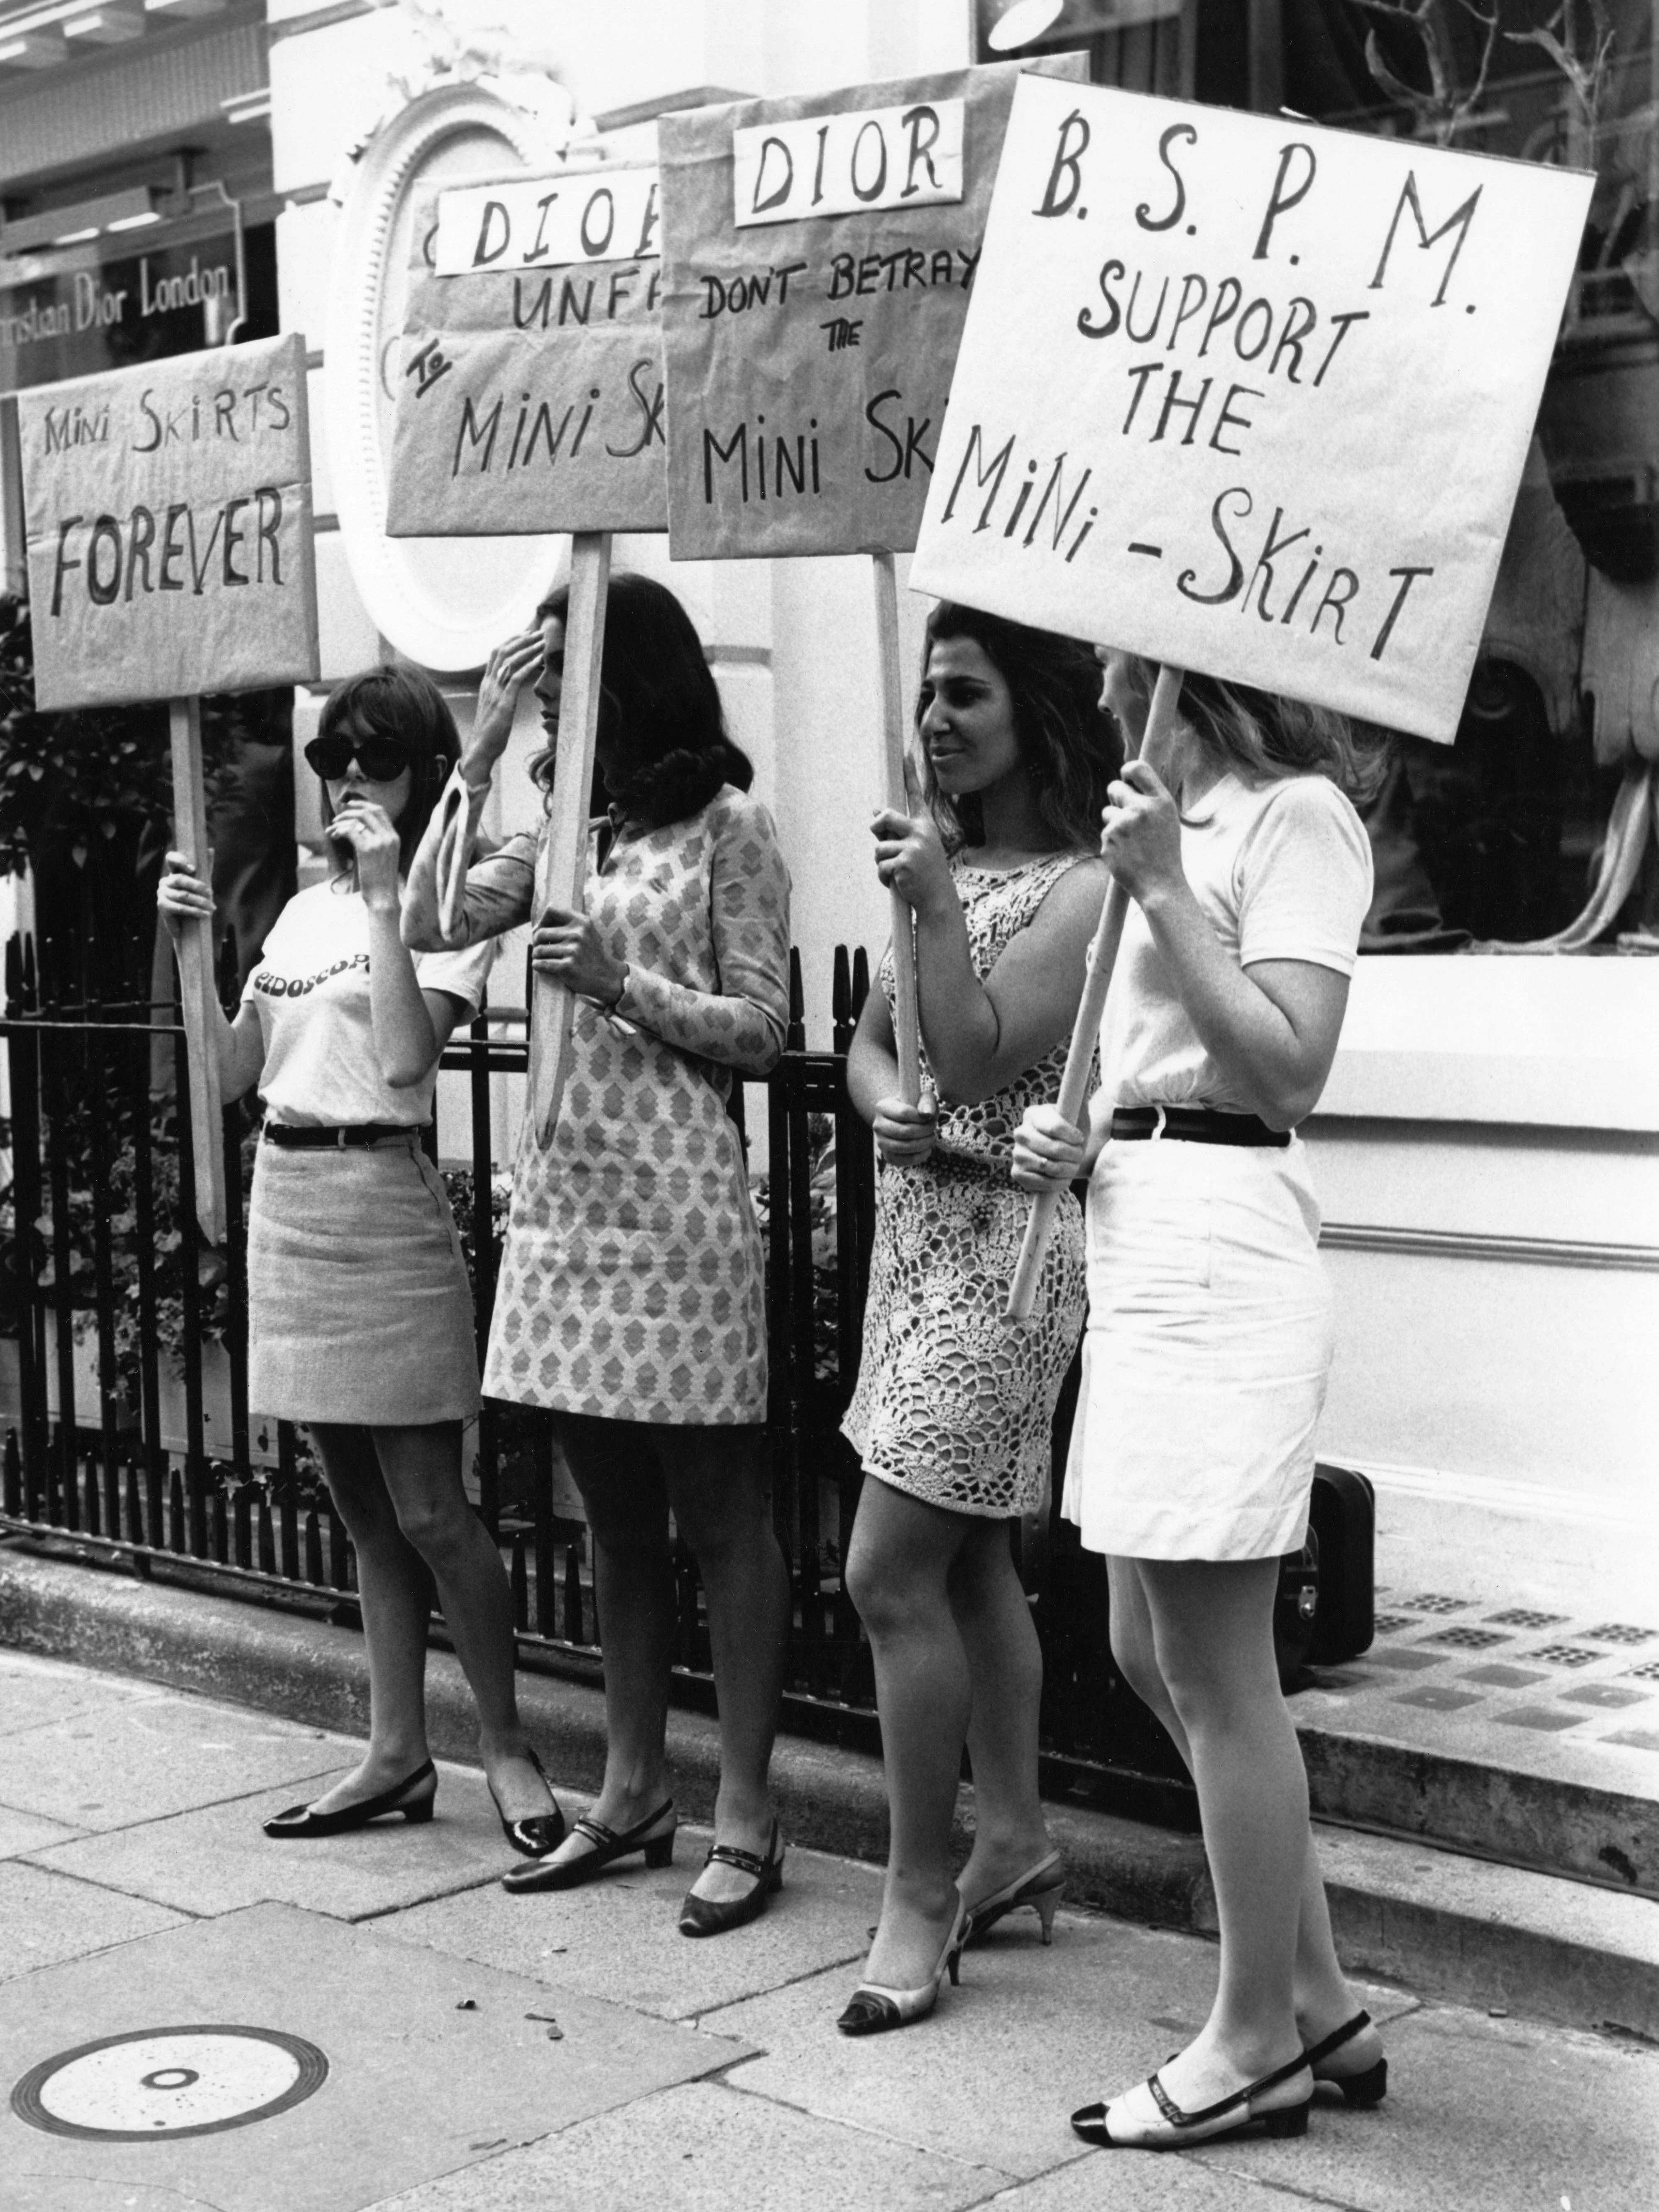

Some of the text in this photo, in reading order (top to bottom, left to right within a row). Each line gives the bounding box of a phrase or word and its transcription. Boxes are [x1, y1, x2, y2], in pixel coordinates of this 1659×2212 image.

[751, 106, 943, 214] DIOR
[0, 257, 230, 346] ristian Dior London
[699, 247, 982, 319] DON'T BETRAY
[1077, 259, 1370, 387] SUPPORT
[820, 317, 864, 352] THE
[864, 389, 949, 482] SK
[1122, 362, 1265, 456] THE
[50, 487, 285, 617] FOREVER
